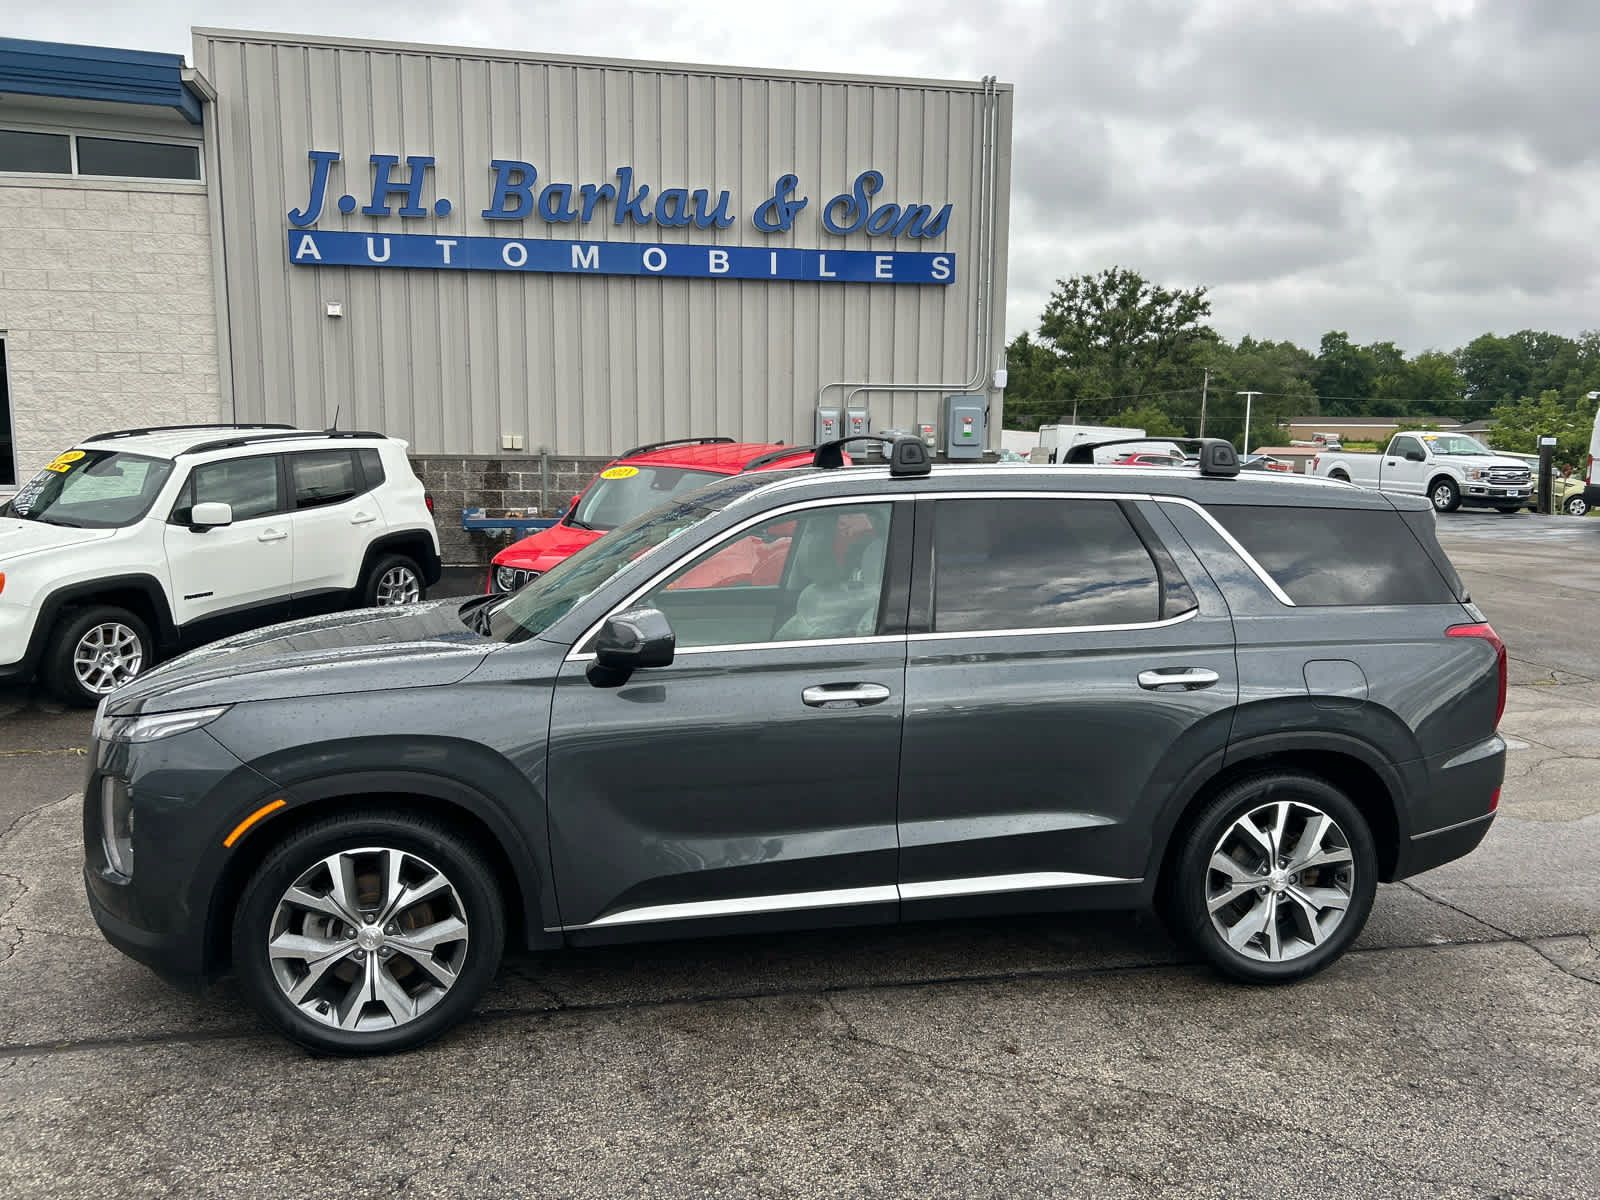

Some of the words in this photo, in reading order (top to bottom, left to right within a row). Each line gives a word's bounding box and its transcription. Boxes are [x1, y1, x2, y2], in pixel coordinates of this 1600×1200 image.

[481, 159, 736, 230] Barkau
[752, 173, 808, 233] &
[822, 169, 953, 239] Sons
[295, 234, 951, 280] AUTOMOBILES
